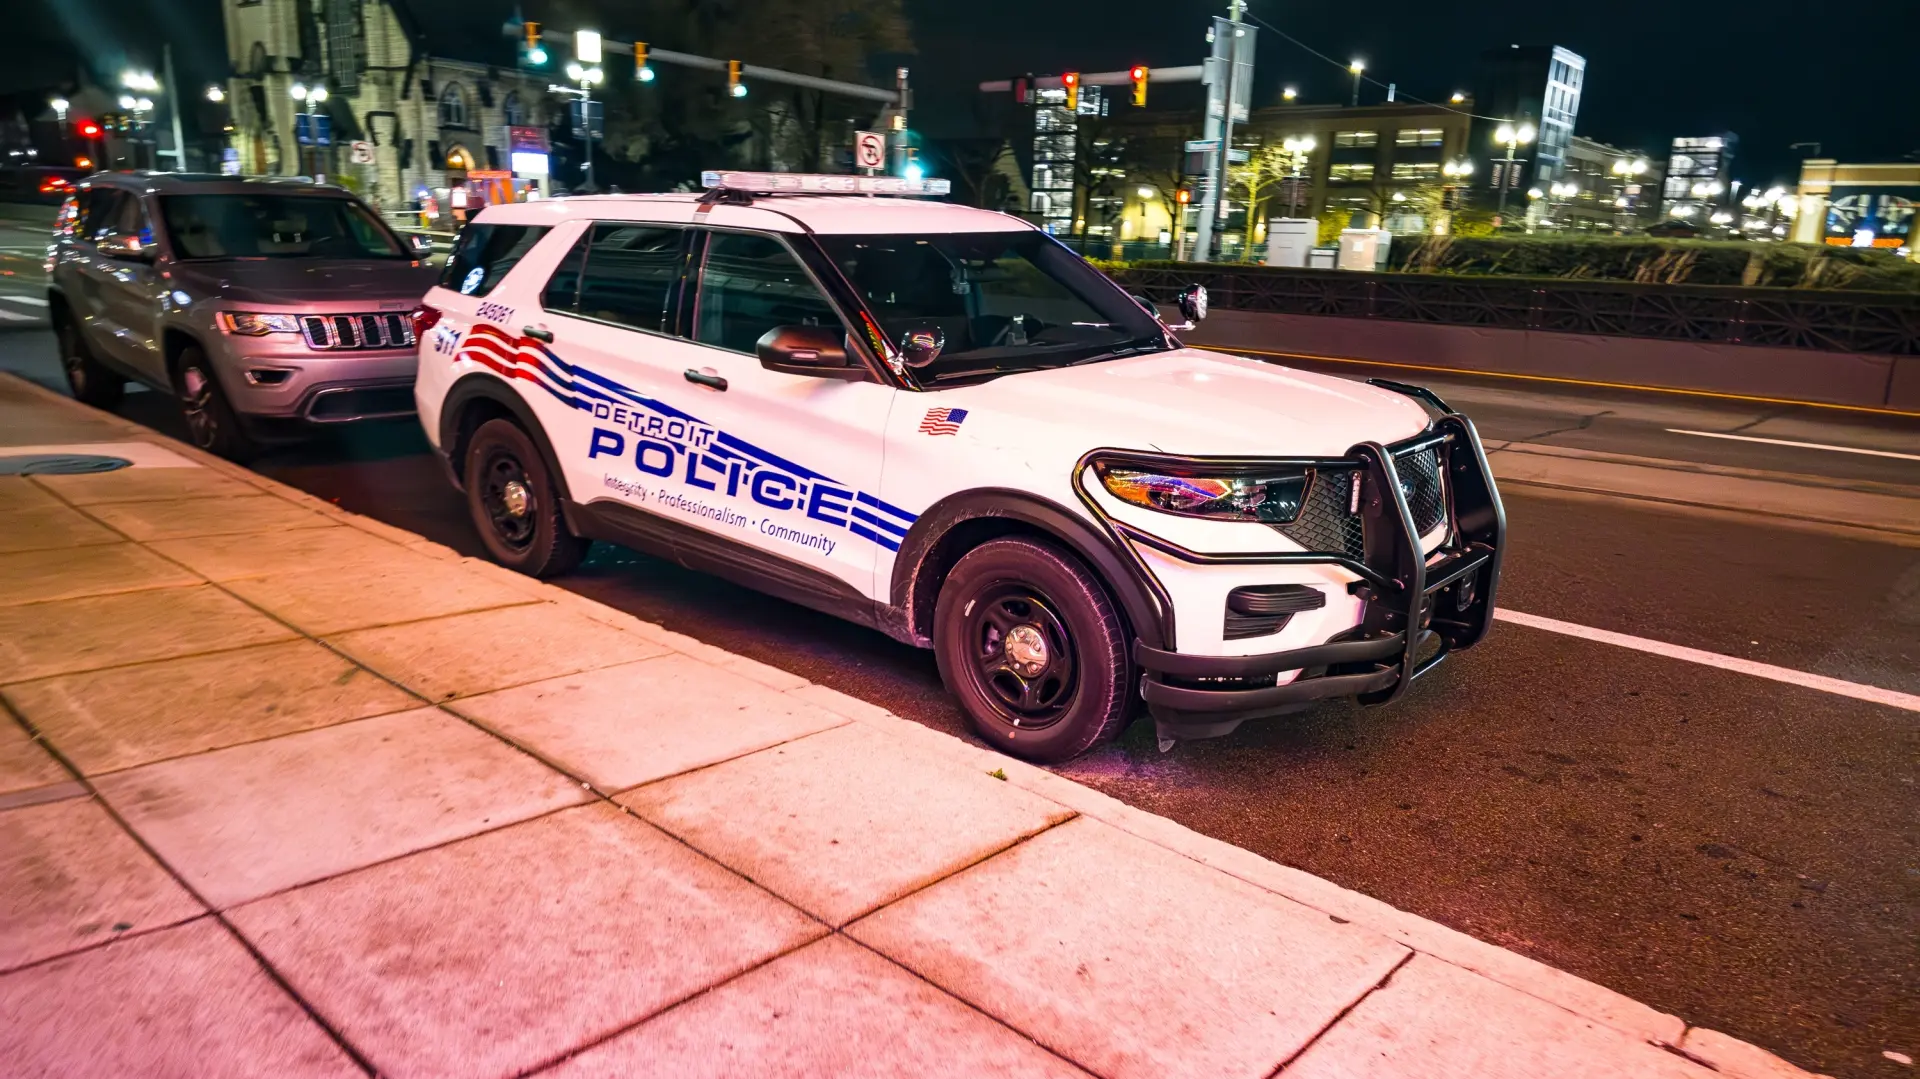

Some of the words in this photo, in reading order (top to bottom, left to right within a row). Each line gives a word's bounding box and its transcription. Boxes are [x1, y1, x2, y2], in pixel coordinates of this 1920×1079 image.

[594, 402, 715, 445] DETROIT
[588, 427, 854, 527] POLICE
[603, 472, 648, 502] Integrity
[658, 489, 747, 528] Professionalism
[760, 518, 836, 556] Community
